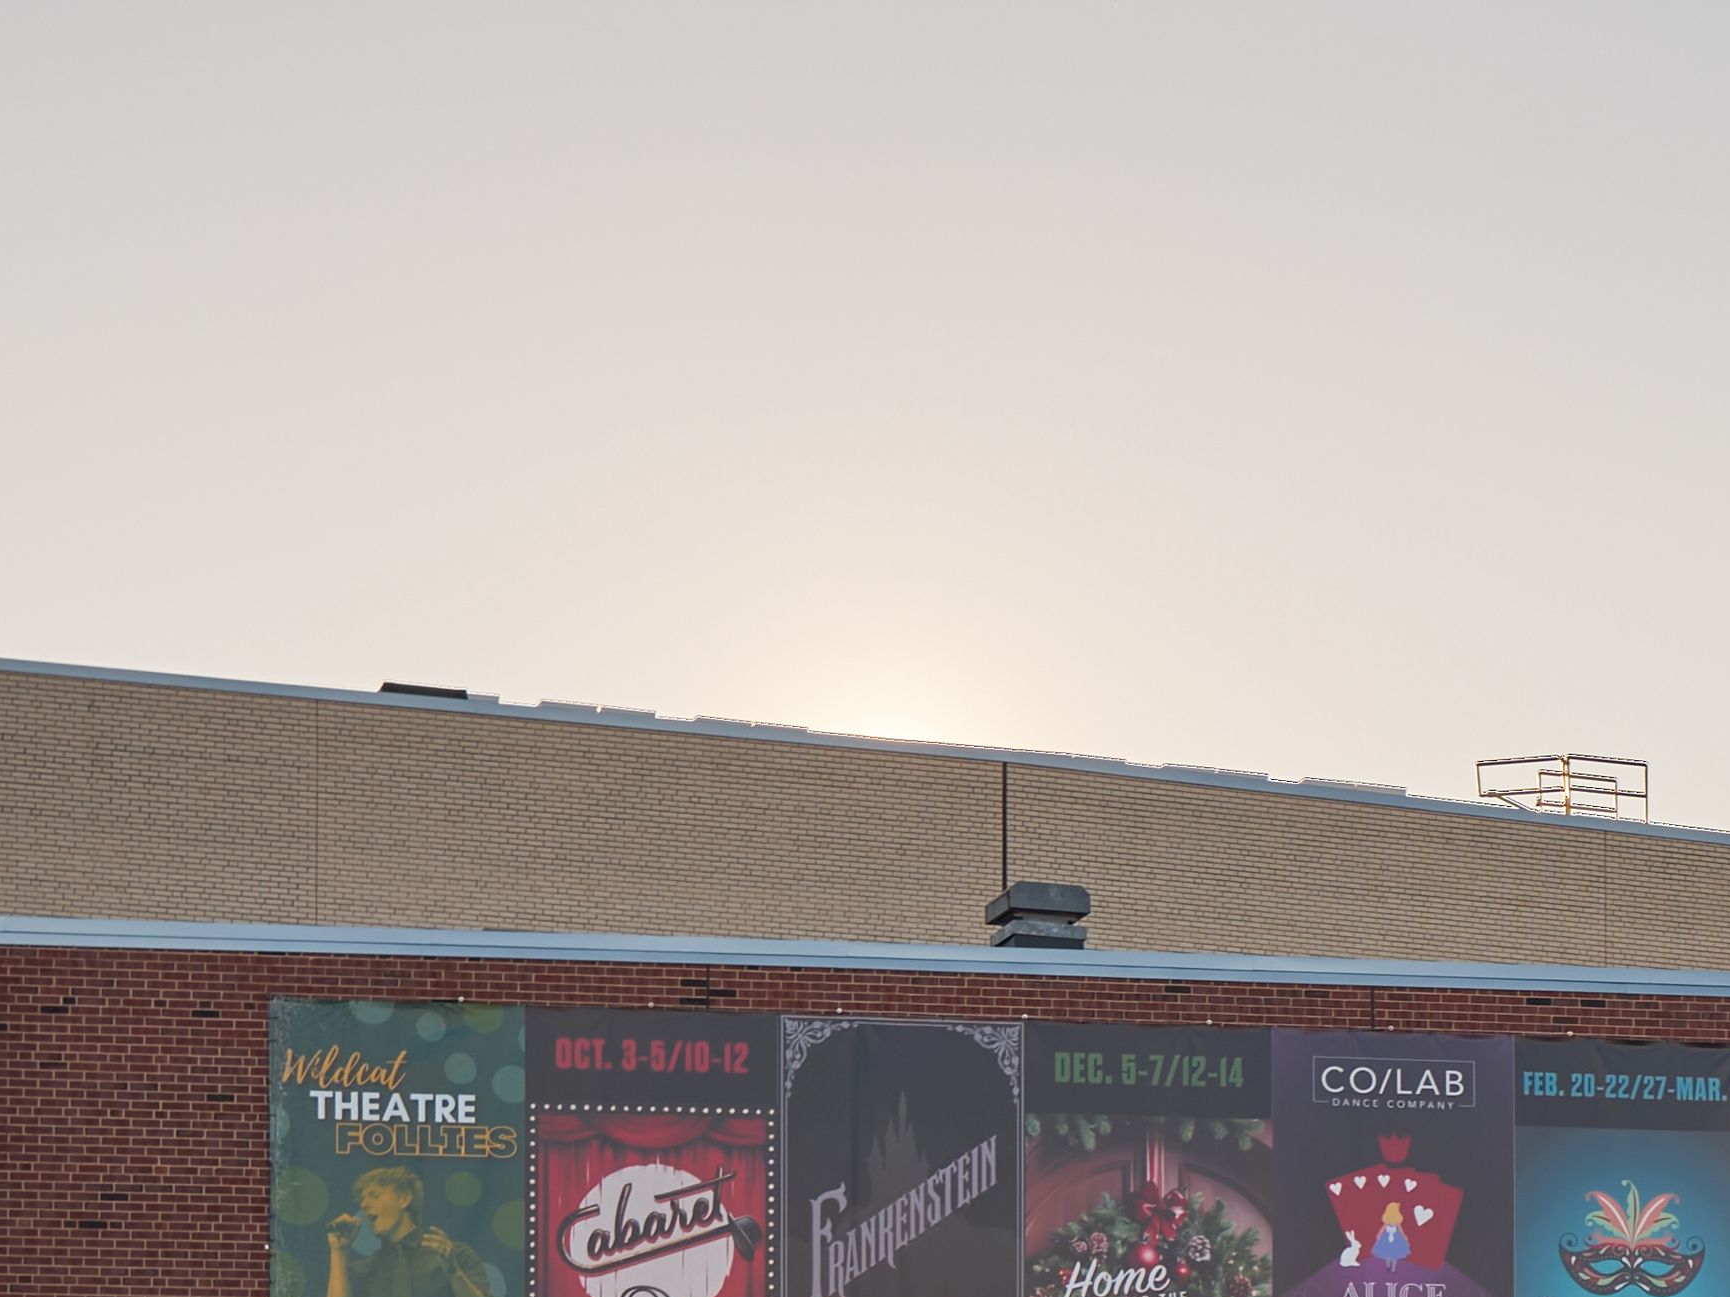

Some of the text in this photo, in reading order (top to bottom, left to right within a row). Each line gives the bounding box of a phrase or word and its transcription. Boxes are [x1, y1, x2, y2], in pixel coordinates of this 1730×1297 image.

[281, 1044, 408, 1090] Wildcat
[555, 1038, 749, 1074] OCT. 3-5/10-12
[1054, 1051, 1244, 1088] DEC. 5-7/12-14
[1321, 1065, 1465, 1097] CO/LAB
[1523, 1071, 1564, 1097] FEB.
[1571, 1073, 1727, 1101] 20-22/27-MAR.
[309, 1089, 476, 1124] THEATRE
[1332, 1098, 1454, 1110] DANCE COMPANY
[336, 1122, 517, 1158] FOLLIES
[557, 1165, 736, 1277] Cabaret
